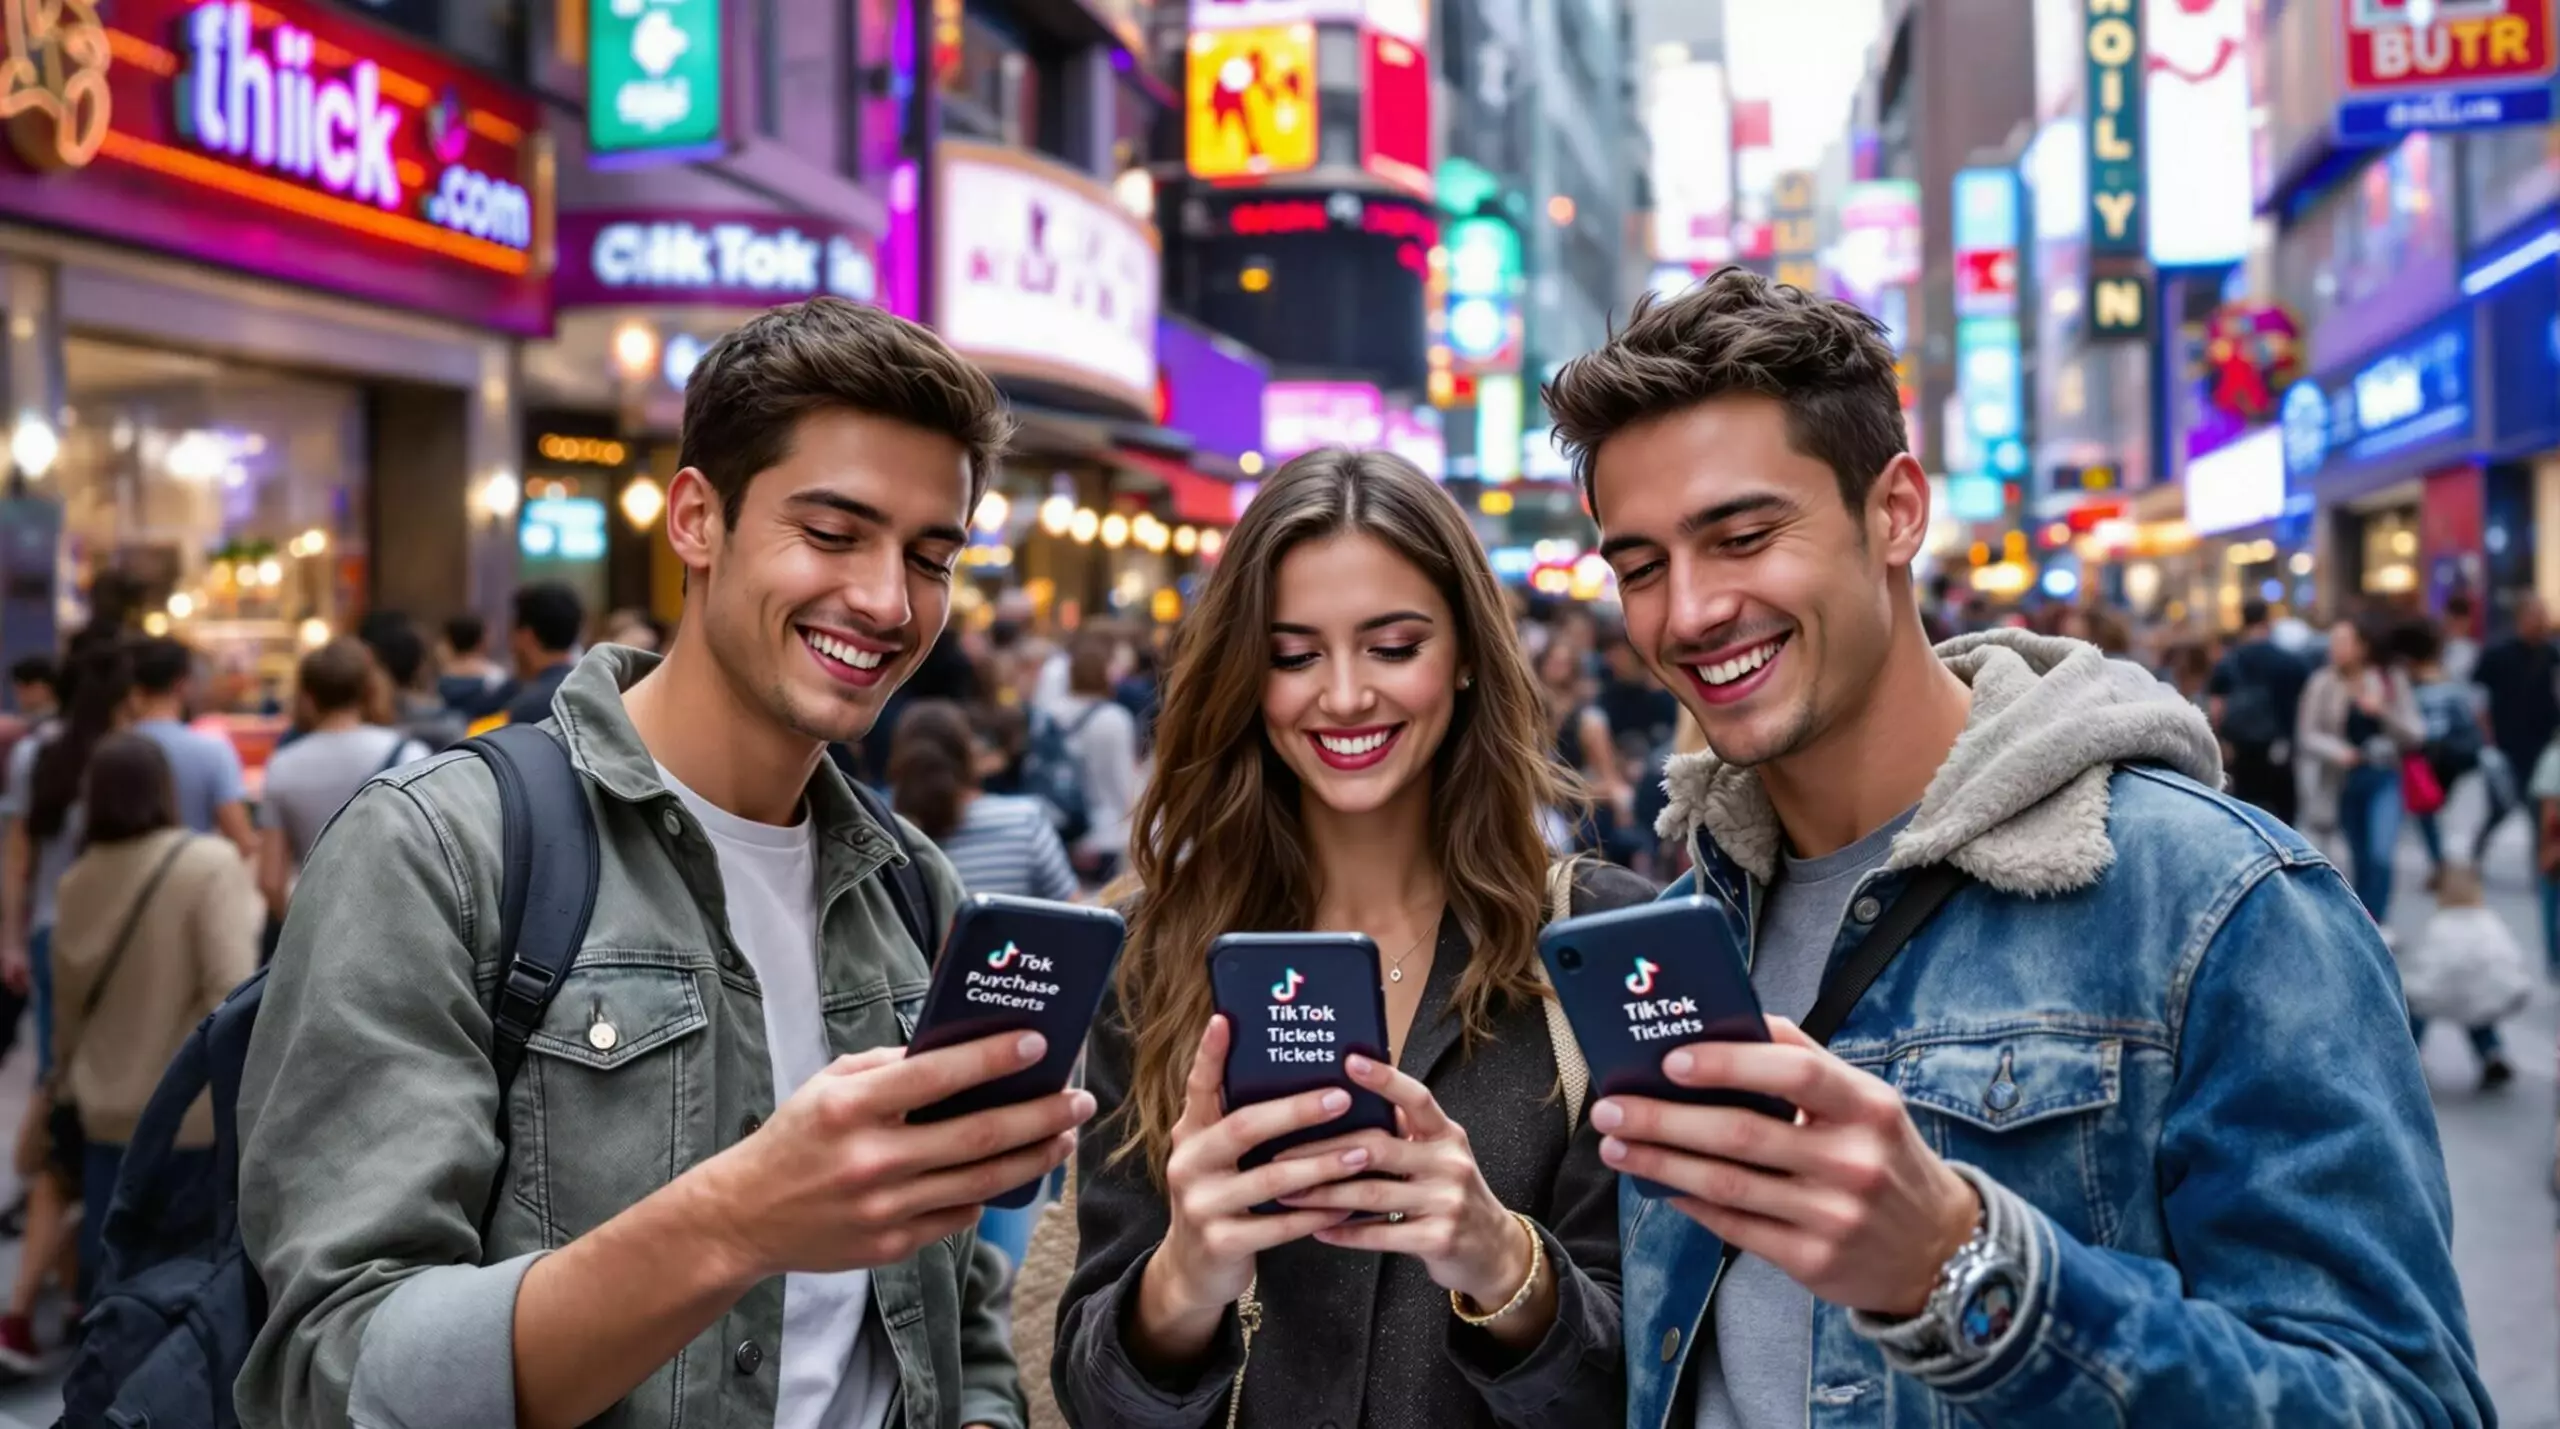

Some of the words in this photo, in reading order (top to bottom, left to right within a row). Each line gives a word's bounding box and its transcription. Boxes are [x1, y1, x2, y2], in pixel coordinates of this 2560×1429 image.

[966, 988, 1045, 1011] Concerts
[1622, 996, 1699, 1021] TikTok
[1267, 1027, 1336, 1043] Tickets
[1628, 1017, 1704, 1041] Tickets
[1266, 1047, 1336, 1062] Tickets
